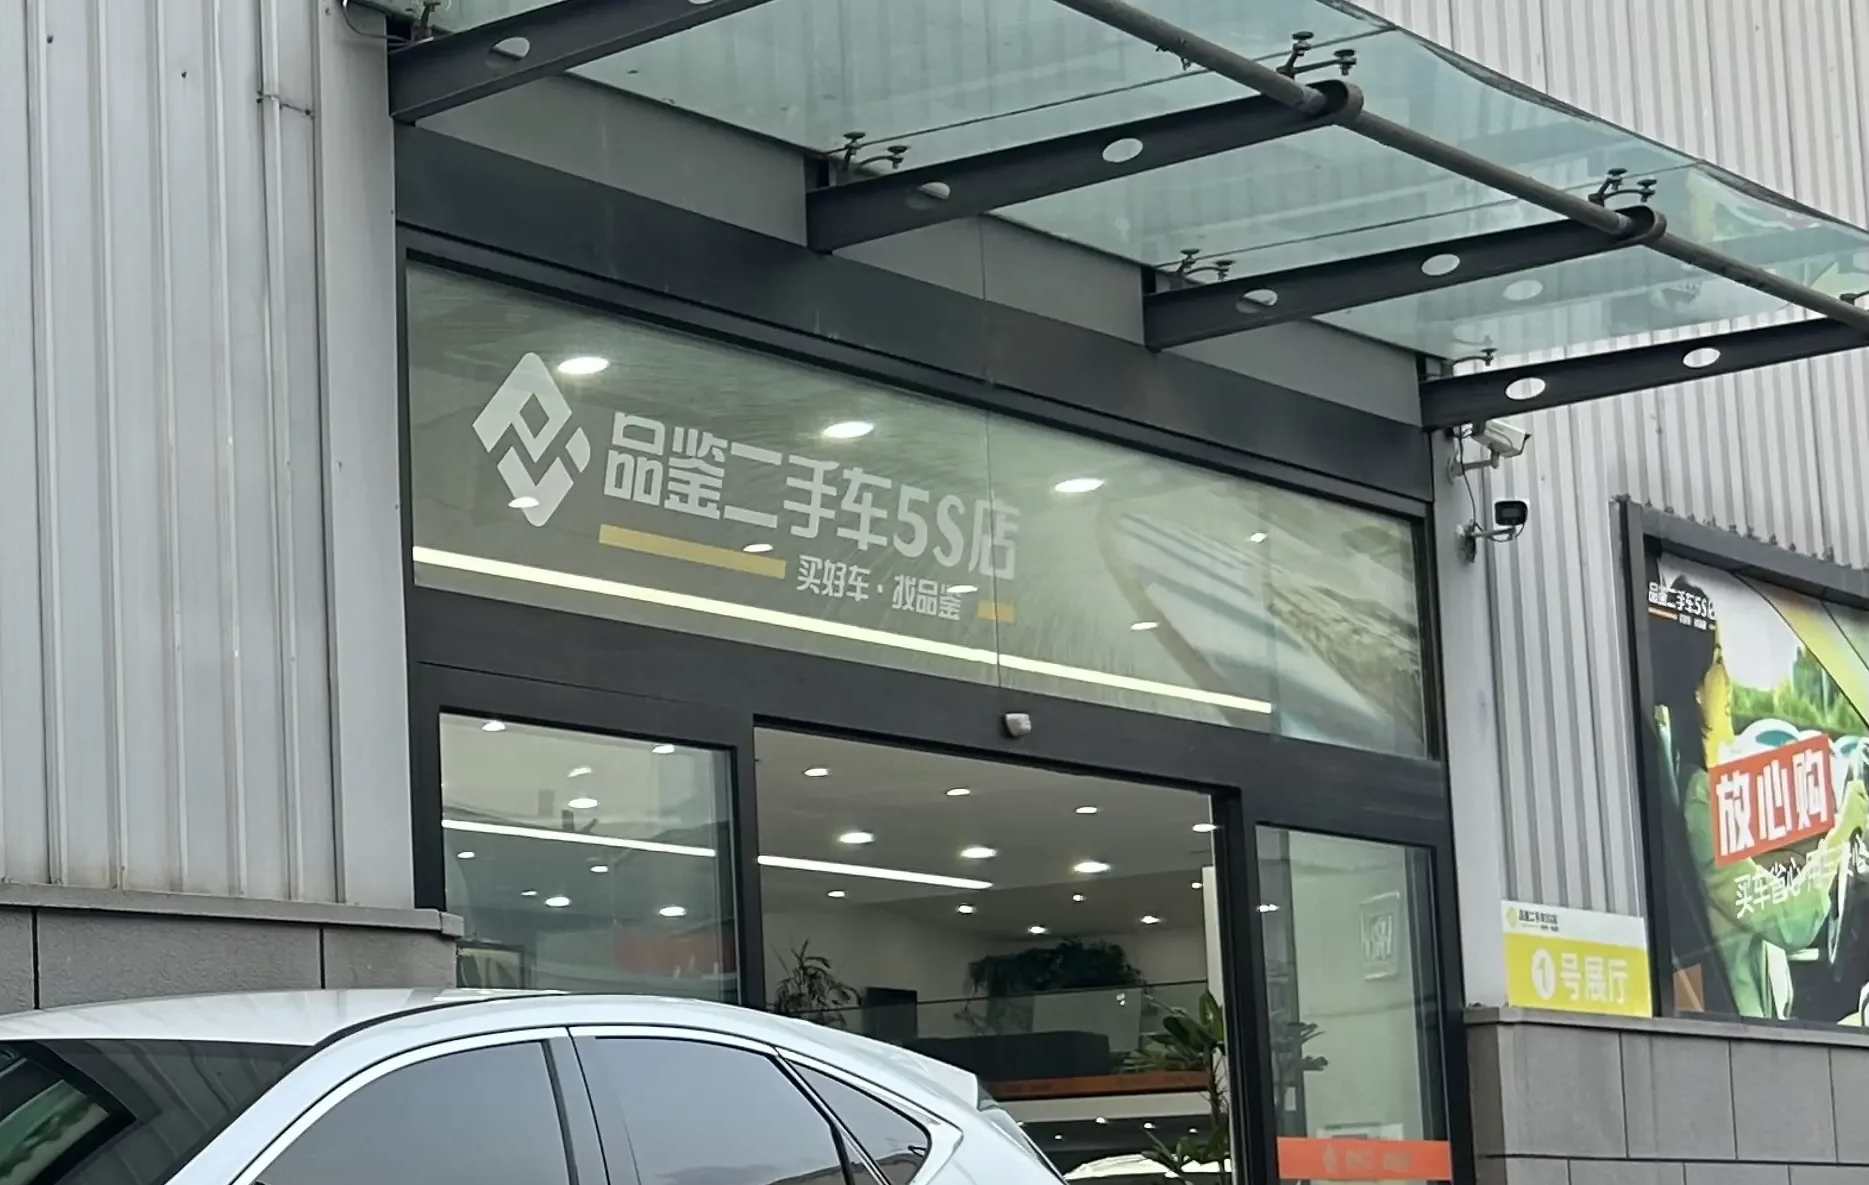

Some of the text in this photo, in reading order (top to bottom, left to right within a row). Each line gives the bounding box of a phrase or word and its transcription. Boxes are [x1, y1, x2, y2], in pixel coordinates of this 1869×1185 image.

[603, 411, 1021, 581] 品鉴二手车5S店
[1715, 748, 1829, 857] 放心购
